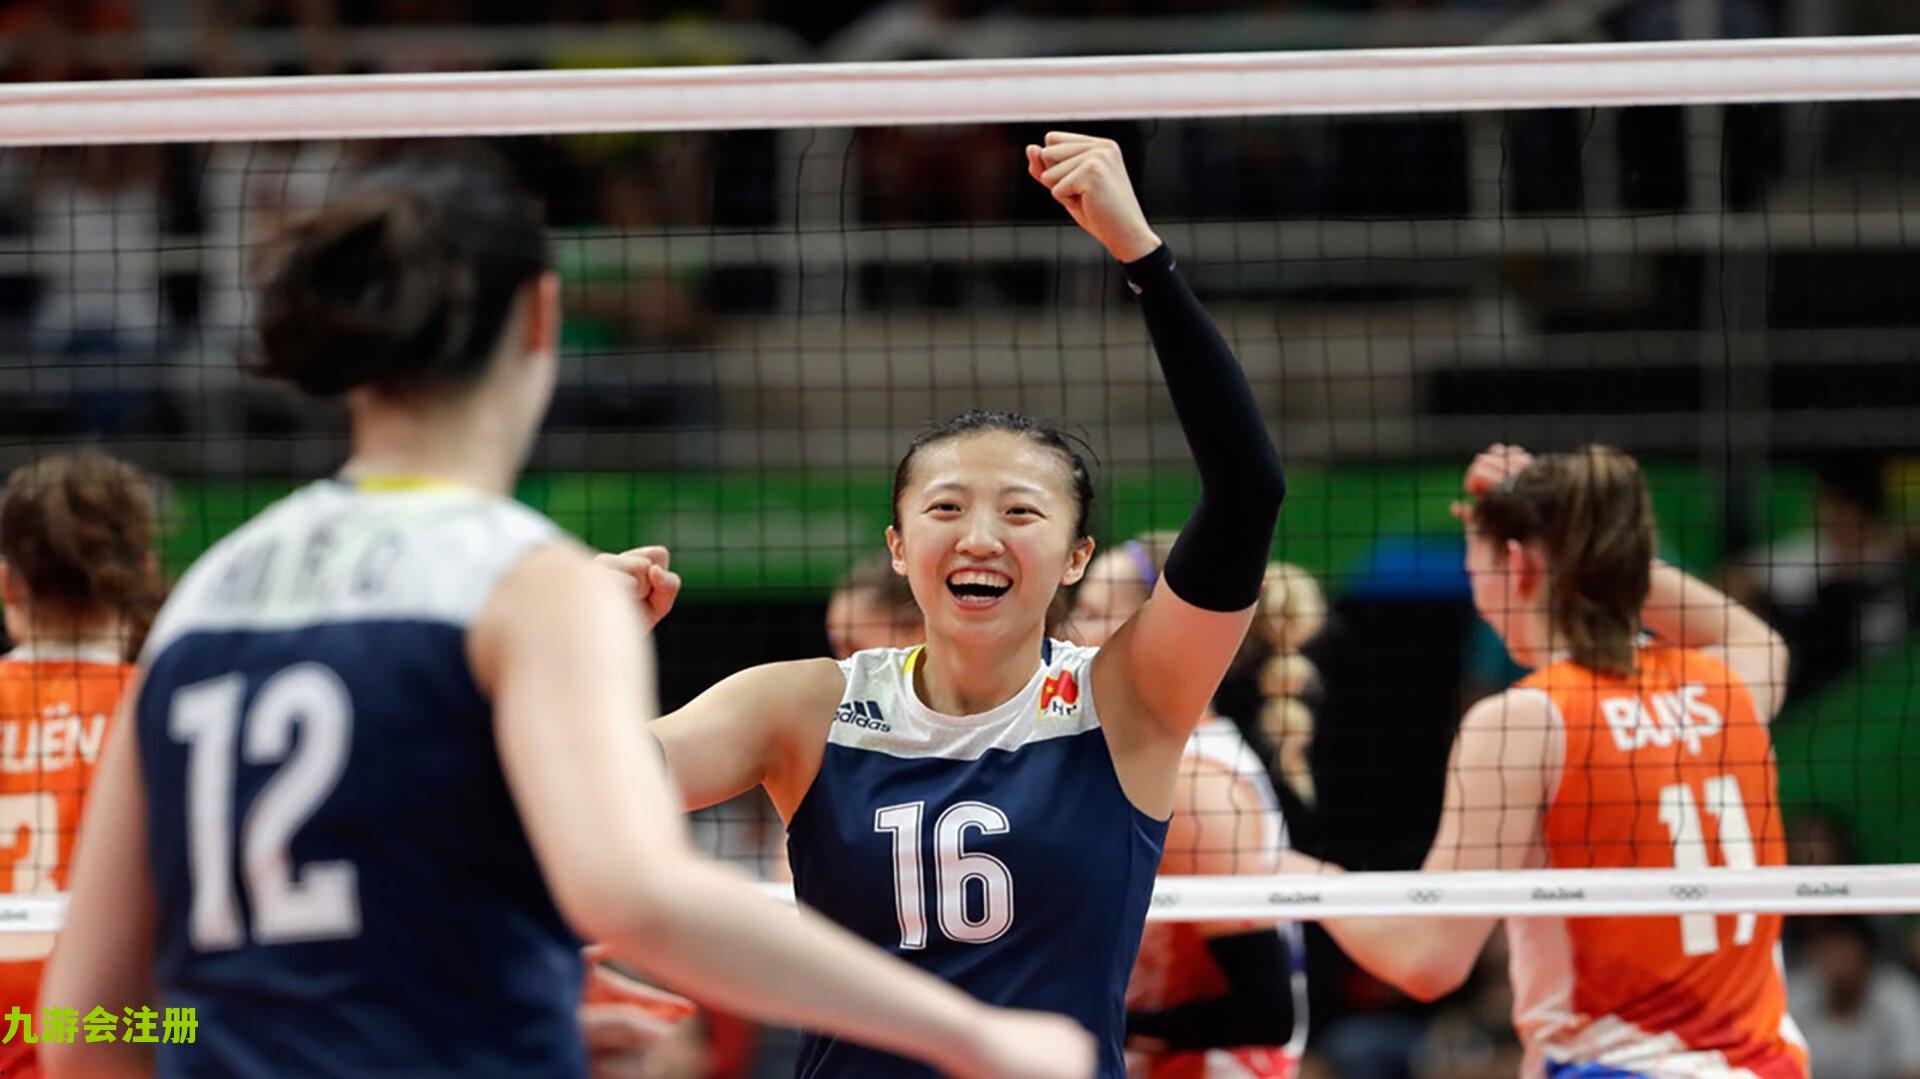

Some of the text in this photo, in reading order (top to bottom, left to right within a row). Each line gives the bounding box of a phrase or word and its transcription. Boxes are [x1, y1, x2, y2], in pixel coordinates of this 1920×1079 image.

[0, 702, 106, 773] LIËN
[167, 660, 362, 953] 12
[874, 801, 1014, 950] 16
[1658, 774, 1756, 956] 11
